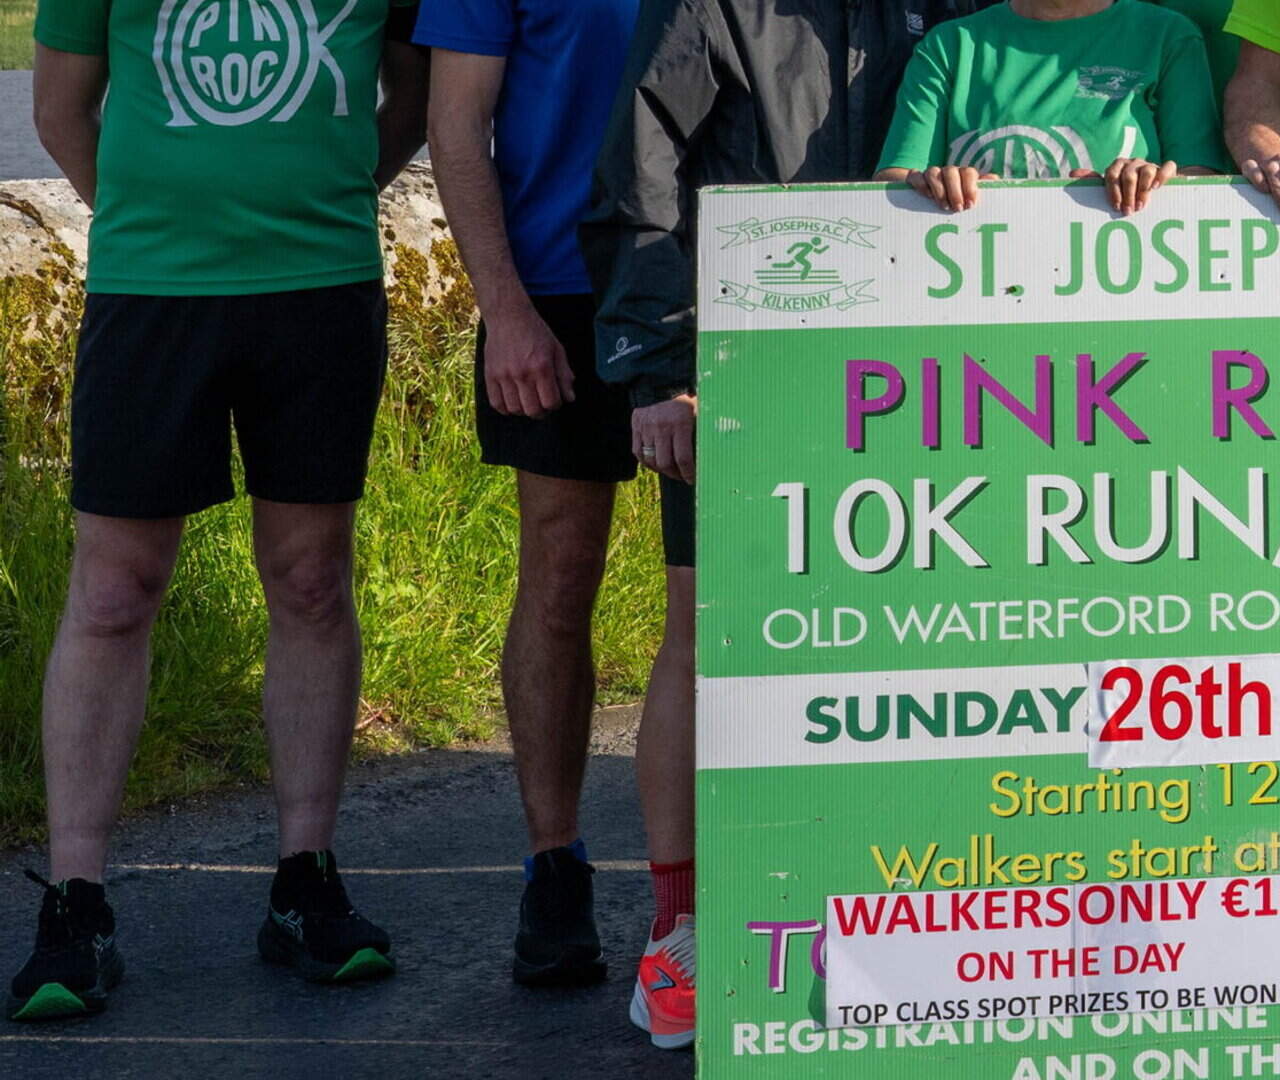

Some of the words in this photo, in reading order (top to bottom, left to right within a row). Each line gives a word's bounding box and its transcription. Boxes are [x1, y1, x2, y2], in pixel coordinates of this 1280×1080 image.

[770, 221, 822, 233] JOSEPHS
[925, 221, 1025, 299] ST.
[762, 292, 831, 311] KILKENNY
[845, 351, 1151, 453] PINK
[771, 474, 992, 575] 10K
[763, 607, 868, 650] OLD
[883, 594, 1192, 646] WATERFORD
[1099, 662, 1272, 743] 26th
[989, 769, 1192, 823] Starting
[1214, 760, 1280, 807] 12
[870, 834, 1088, 891] Walkers
[1107, 834, 1218, 881] start
[956, 951, 1014, 983] ON
[1027, 947, 1100, 980] THE
[1113, 942, 1187, 975] DAY
[838, 1003, 888, 1026] TOP
[896, 999, 970, 1021] CLASS
[977, 994, 1041, 1019] SPOT
[1049, 990, 1129, 1016] PRIZES
[1136, 989, 1169, 1010] TO
[1177, 987, 1206, 1008] BE
[1091, 1003, 1268, 1038] ONLINE
[1009, 1052, 1117, 1080] AND
[1132, 1048, 1210, 1080] ON
